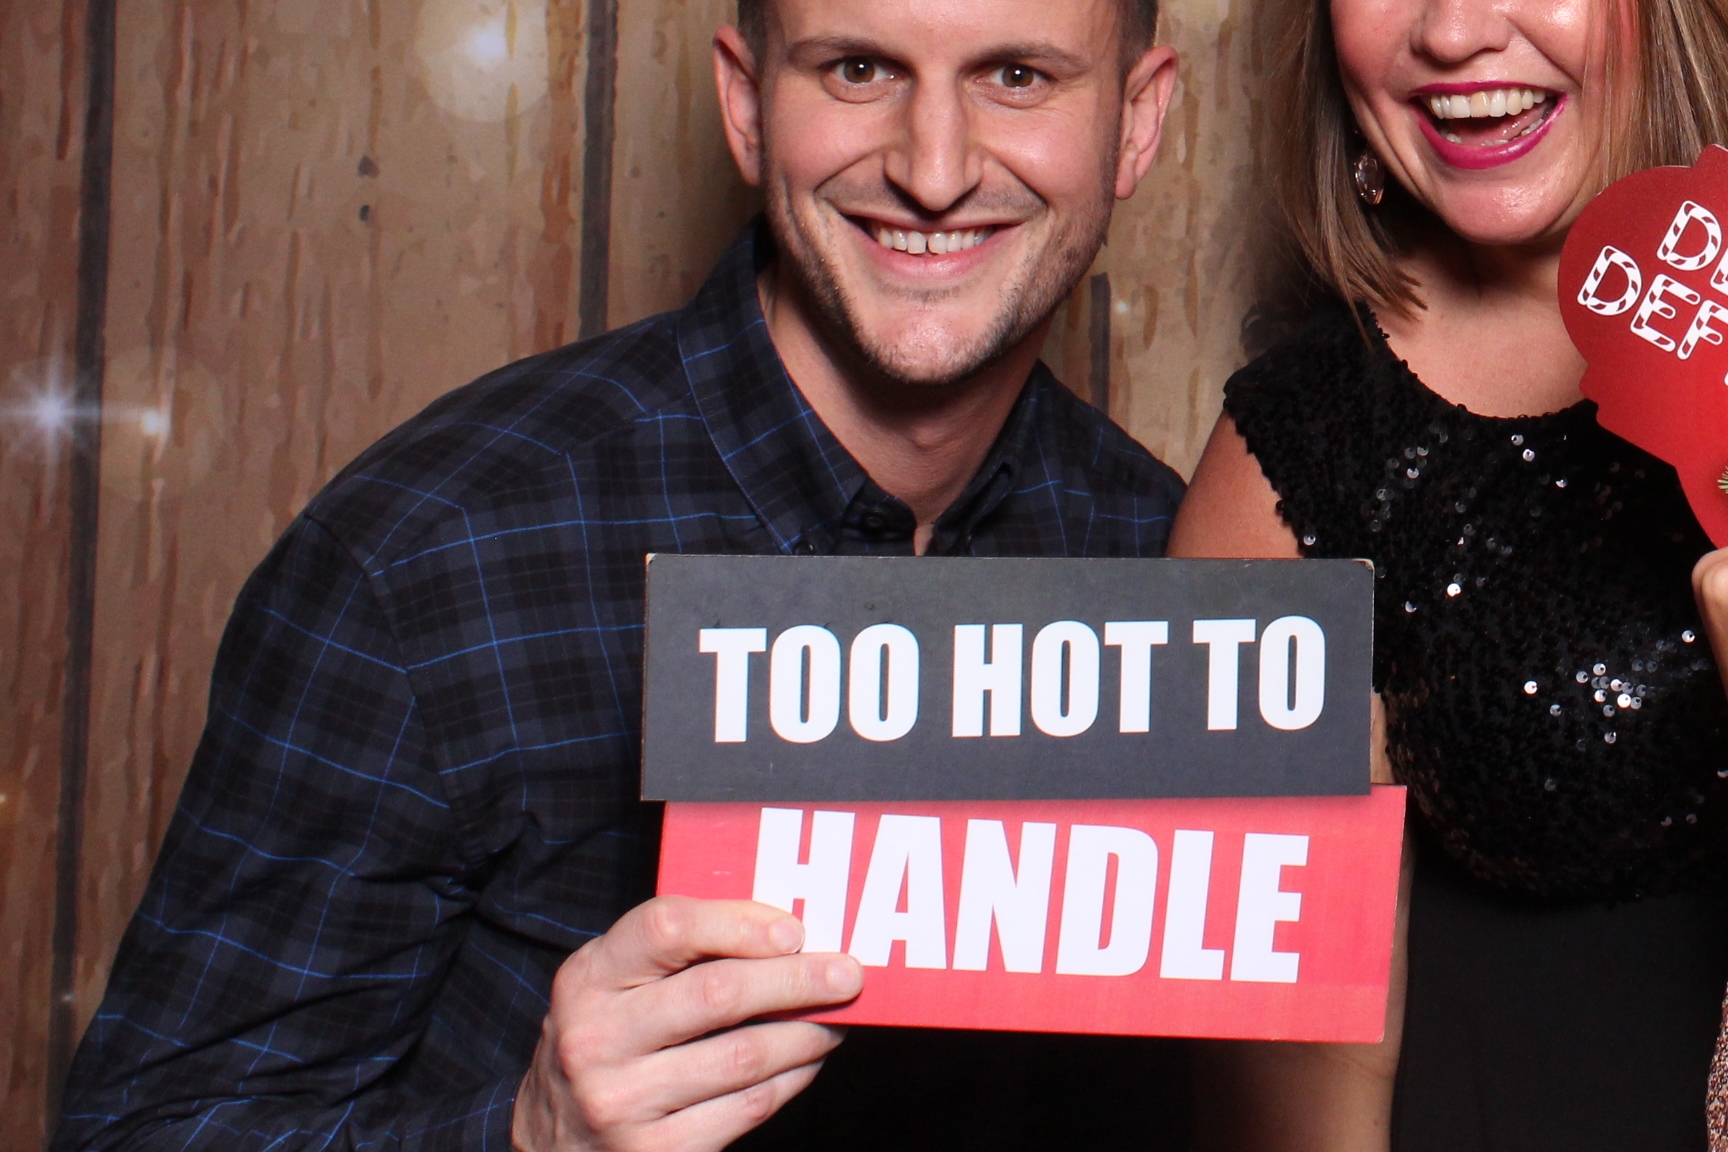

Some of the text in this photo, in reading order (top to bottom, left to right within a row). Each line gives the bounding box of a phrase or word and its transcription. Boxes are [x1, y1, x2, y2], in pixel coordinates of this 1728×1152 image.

[698, 615, 1326, 743] TOO HOT TO
[752, 806, 1310, 984] HANDLE
